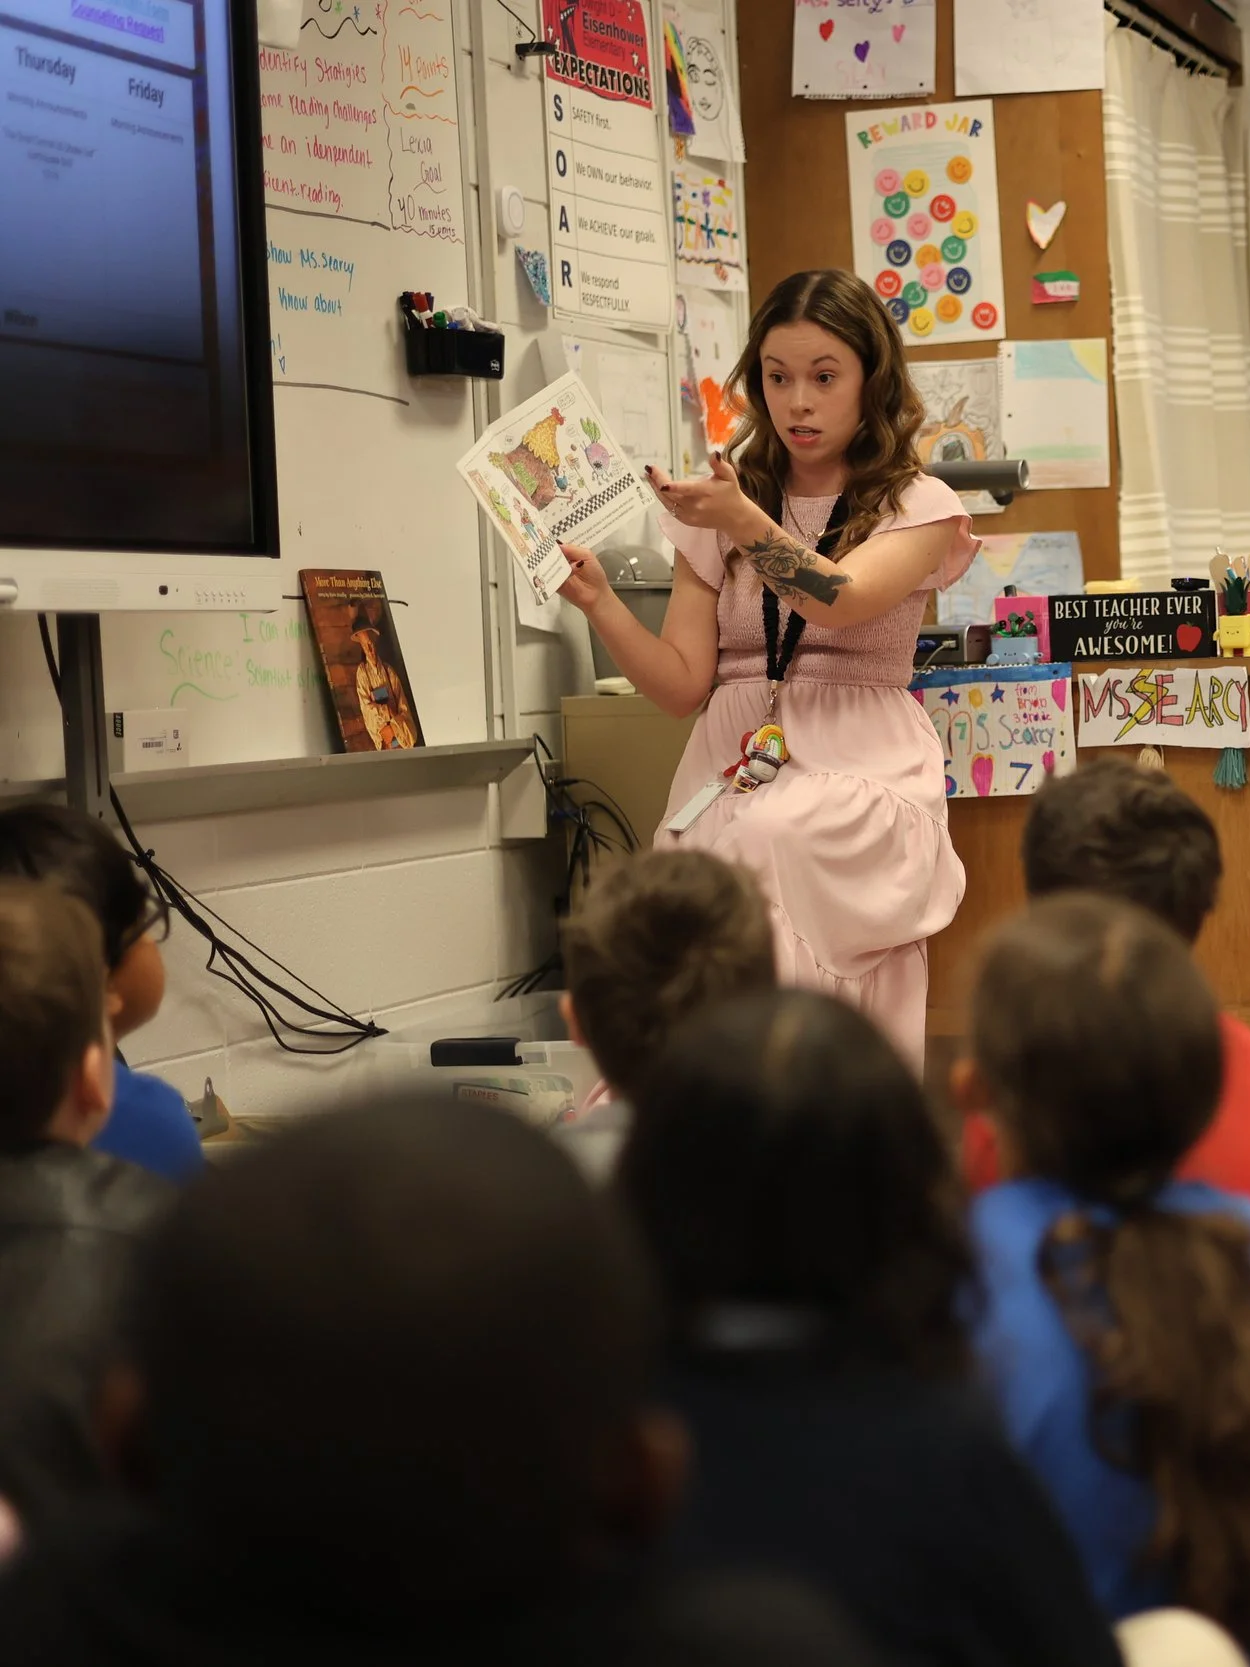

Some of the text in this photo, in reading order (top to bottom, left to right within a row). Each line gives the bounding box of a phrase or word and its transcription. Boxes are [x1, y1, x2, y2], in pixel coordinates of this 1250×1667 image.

[582, 11, 645, 48] Eisenhower
[583, 30, 626, 62] Elementary
[15, 44, 77, 87] Thursday
[259, 48, 308, 87] dentify
[398, 45, 412, 83] 14
[553, 51, 651, 100] EXPECTATIONS
[128, 77, 165, 109] Friday
[553, 94, 564, 122] S
[572, 106, 595, 126] SAFETY
[400, 127, 433, 155] Lexia
[857, 111, 983, 149] REWARD JAR
[281, 136, 297, 155] an
[420, 161, 442, 183] Goal
[556, 150, 567, 178] O
[576, 160, 654, 191] We OWN our behavior.
[419, 202, 452, 222] minutes
[559, 205, 570, 233] A
[578, 215, 657, 244] We ACHIEVE our goals.
[561, 260, 573, 288] R
[581, 270, 620, 290] We respond
[314, 296, 343, 315] about
[314, 576, 330, 588] More
[329, 575, 347, 588] Than
[1055, 595, 1202, 619] BEST TEACHER EVER
[1103, 616, 1144, 635] you're
[1074, 634, 1173, 657] AWESOME!
[1015, 682, 1039, 697] from
[1013, 711, 1053, 725] 3 grade
[998, 714, 1056, 751] Searcy
[1009, 761, 1033, 791] 7
